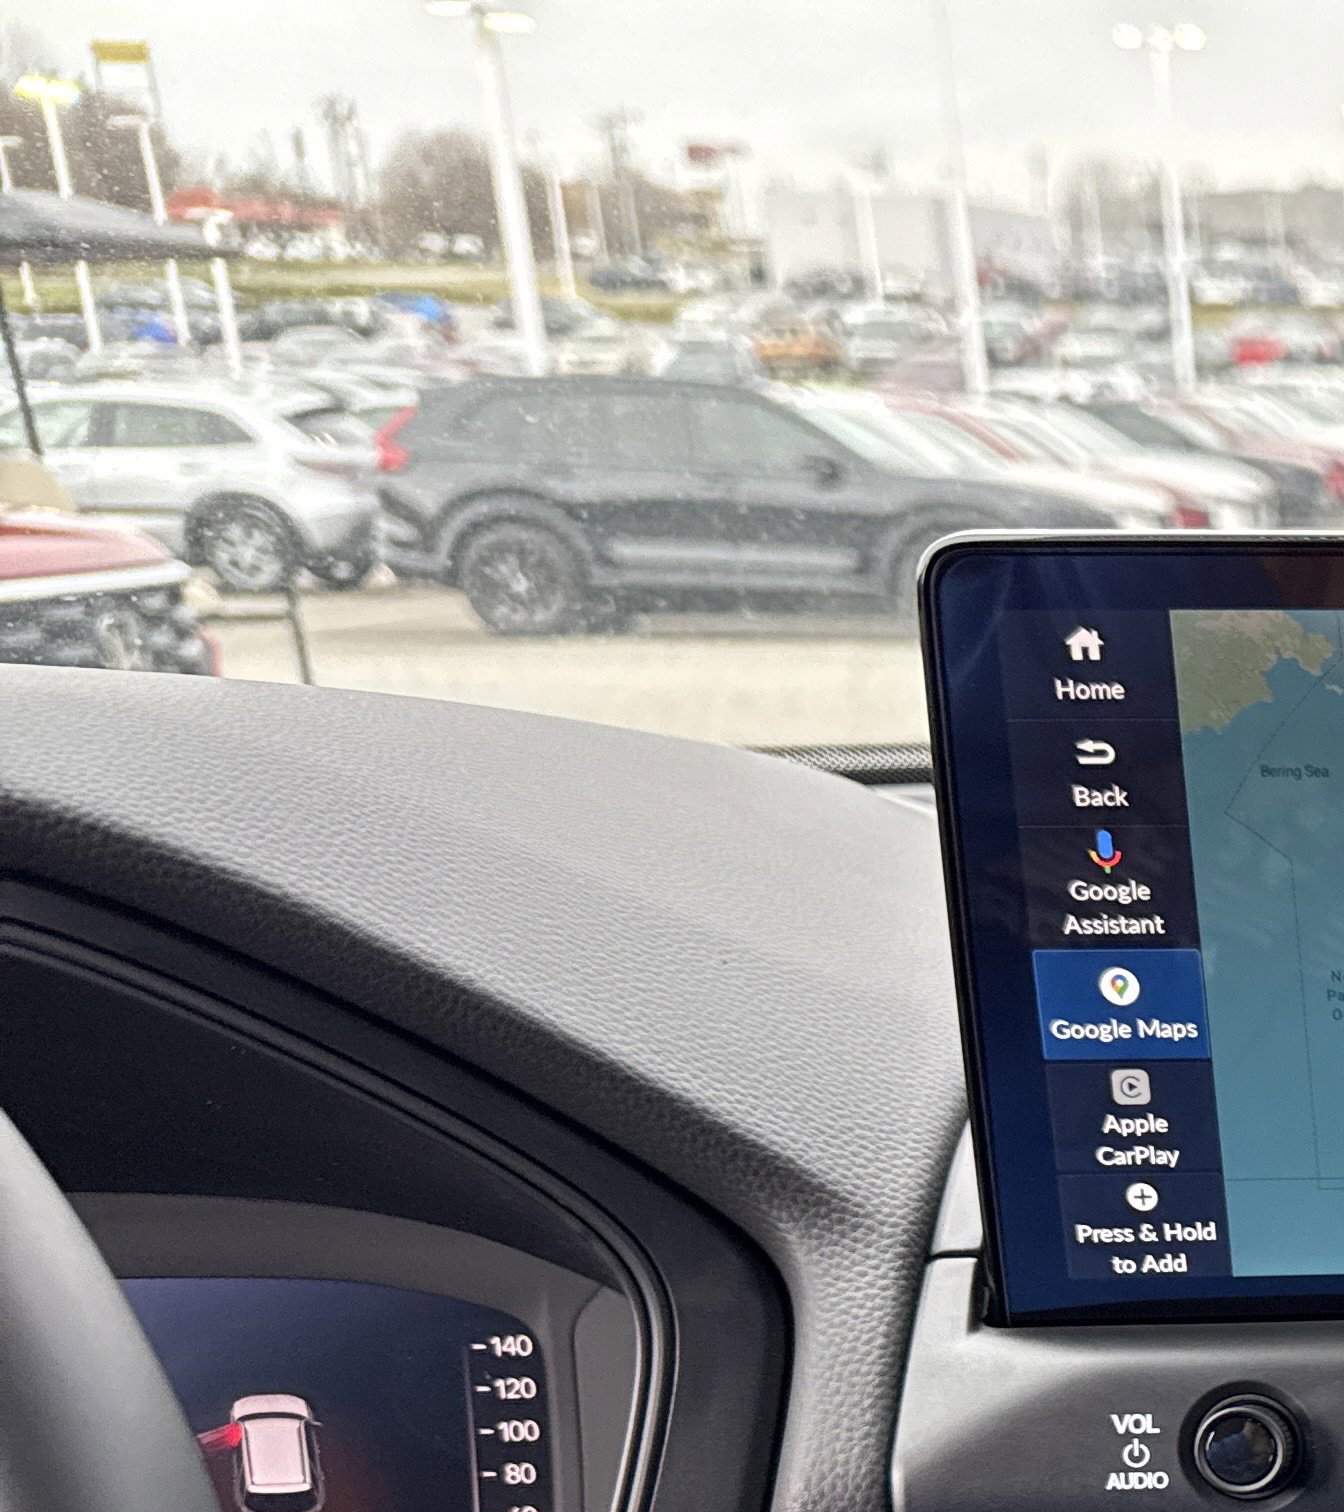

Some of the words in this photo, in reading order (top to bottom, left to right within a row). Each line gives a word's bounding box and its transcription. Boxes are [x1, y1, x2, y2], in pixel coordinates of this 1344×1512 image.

[1054, 677, 1125, 700] Home
[1260, 765, 1302, 780] Bering
[1304, 765, 1330, 778] Sea
[1071, 783, 1129, 807] Back
[1067, 879, 1151, 904] Google
[1063, 912, 1165, 935] Assistant
[1050, 1018, 1132, 1043] Google
[1136, 1017, 1198, 1042] Maps
[1102, 1113, 1168, 1137] Apple
[1095, 1146, 1180, 1168] CarPlay
[1075, 1224, 1134, 1243] Press
[1139, 1223, 1158, 1242] &
[1162, 1222, 1217, 1242] Hold
[1111, 1256, 1136, 1274] to
[1141, 1253, 1188, 1273] Add
[489, 1334, 533, 1357] 140
[494, 1377, 537, 1400] 120
[497, 1419, 540, 1442] 100
[1110, 1414, 1161, 1435] VOL
[504, 1462, 537, 1486] 80
[1105, 1472, 1169, 1491] AUDIO
